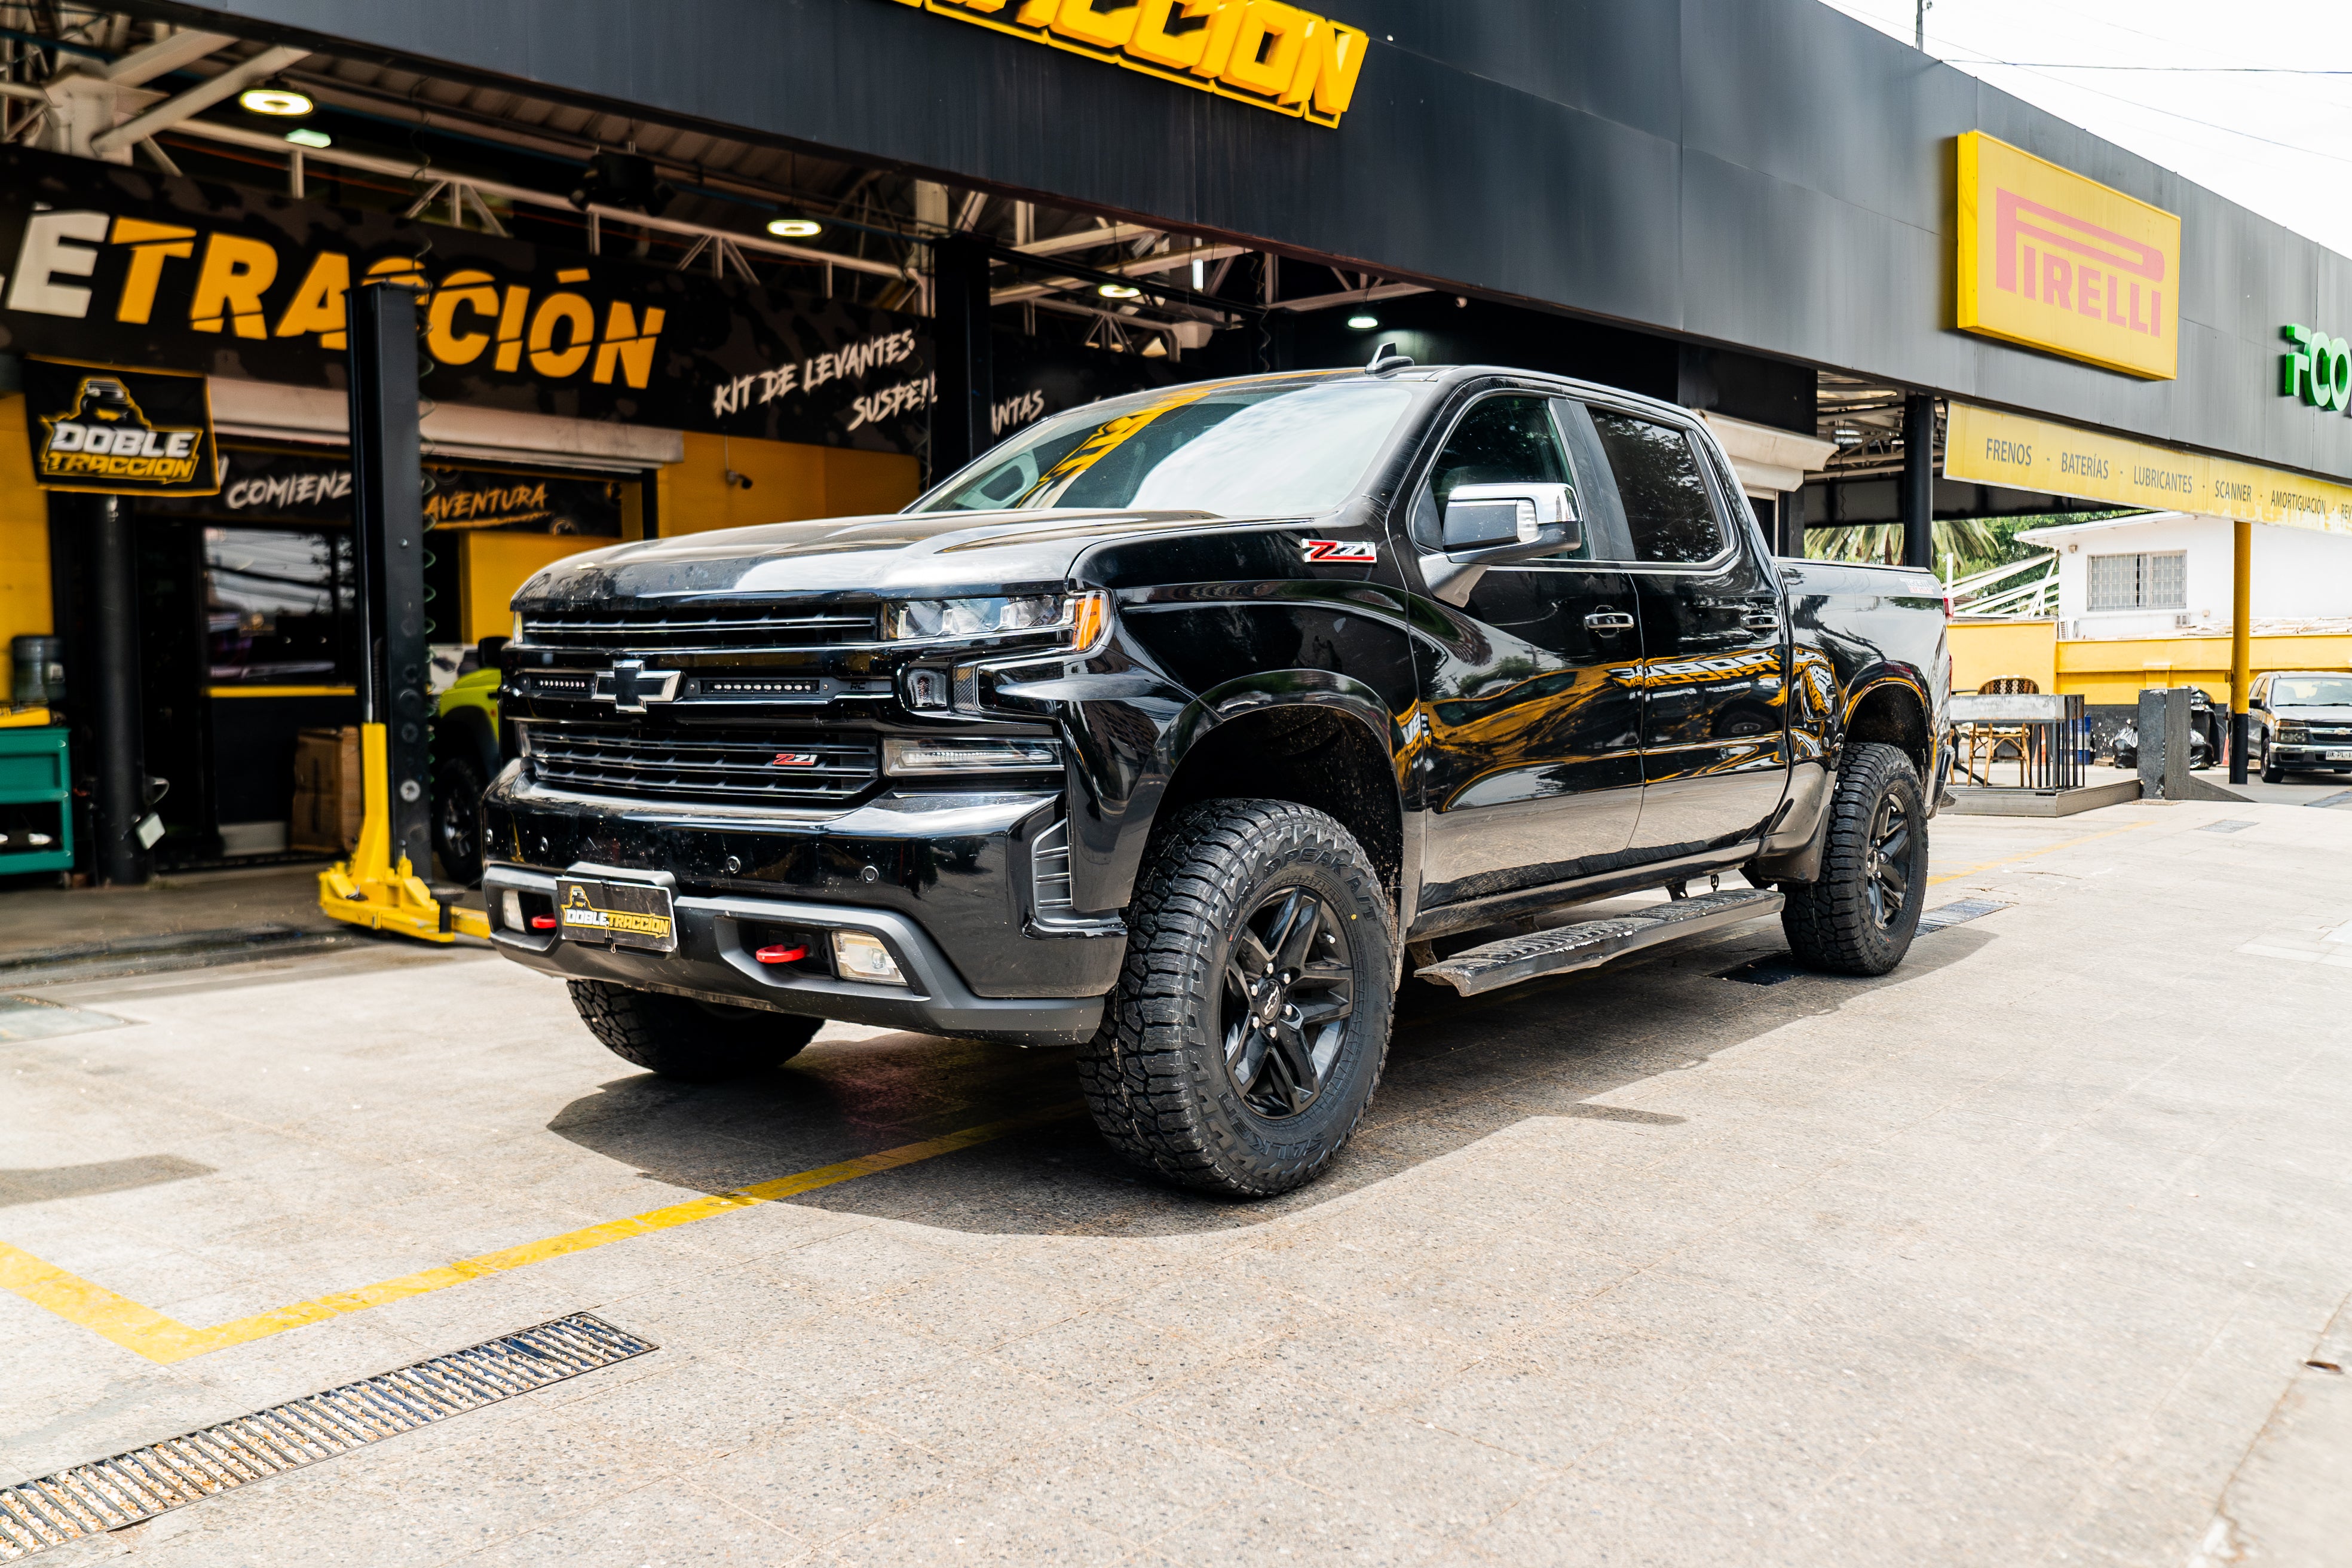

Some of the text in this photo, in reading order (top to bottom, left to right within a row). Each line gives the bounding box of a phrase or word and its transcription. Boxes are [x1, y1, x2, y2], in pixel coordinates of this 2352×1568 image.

[1996, 187, 2165, 338] PIRELLI
[713, 329, 915, 418] KIT DE LEVANTES
[50, 421, 197, 458] DOBLE
[48, 451, 194, 478] TRACCION
[1986, 437, 2032, 466] FRENOS
[2061, 452, 2109, 480] BATERÍAS
[2134, 465, 2192, 494] LUBRICANTES
[2215, 480, 2252, 503] SCANNER
[2271, 489, 2326, 516] AMORTIGUACIÓN
[423, 482, 549, 520] AVENTURA
[1301, 538, 1377, 564] Z71
[773, 754, 818, 765] Z71
